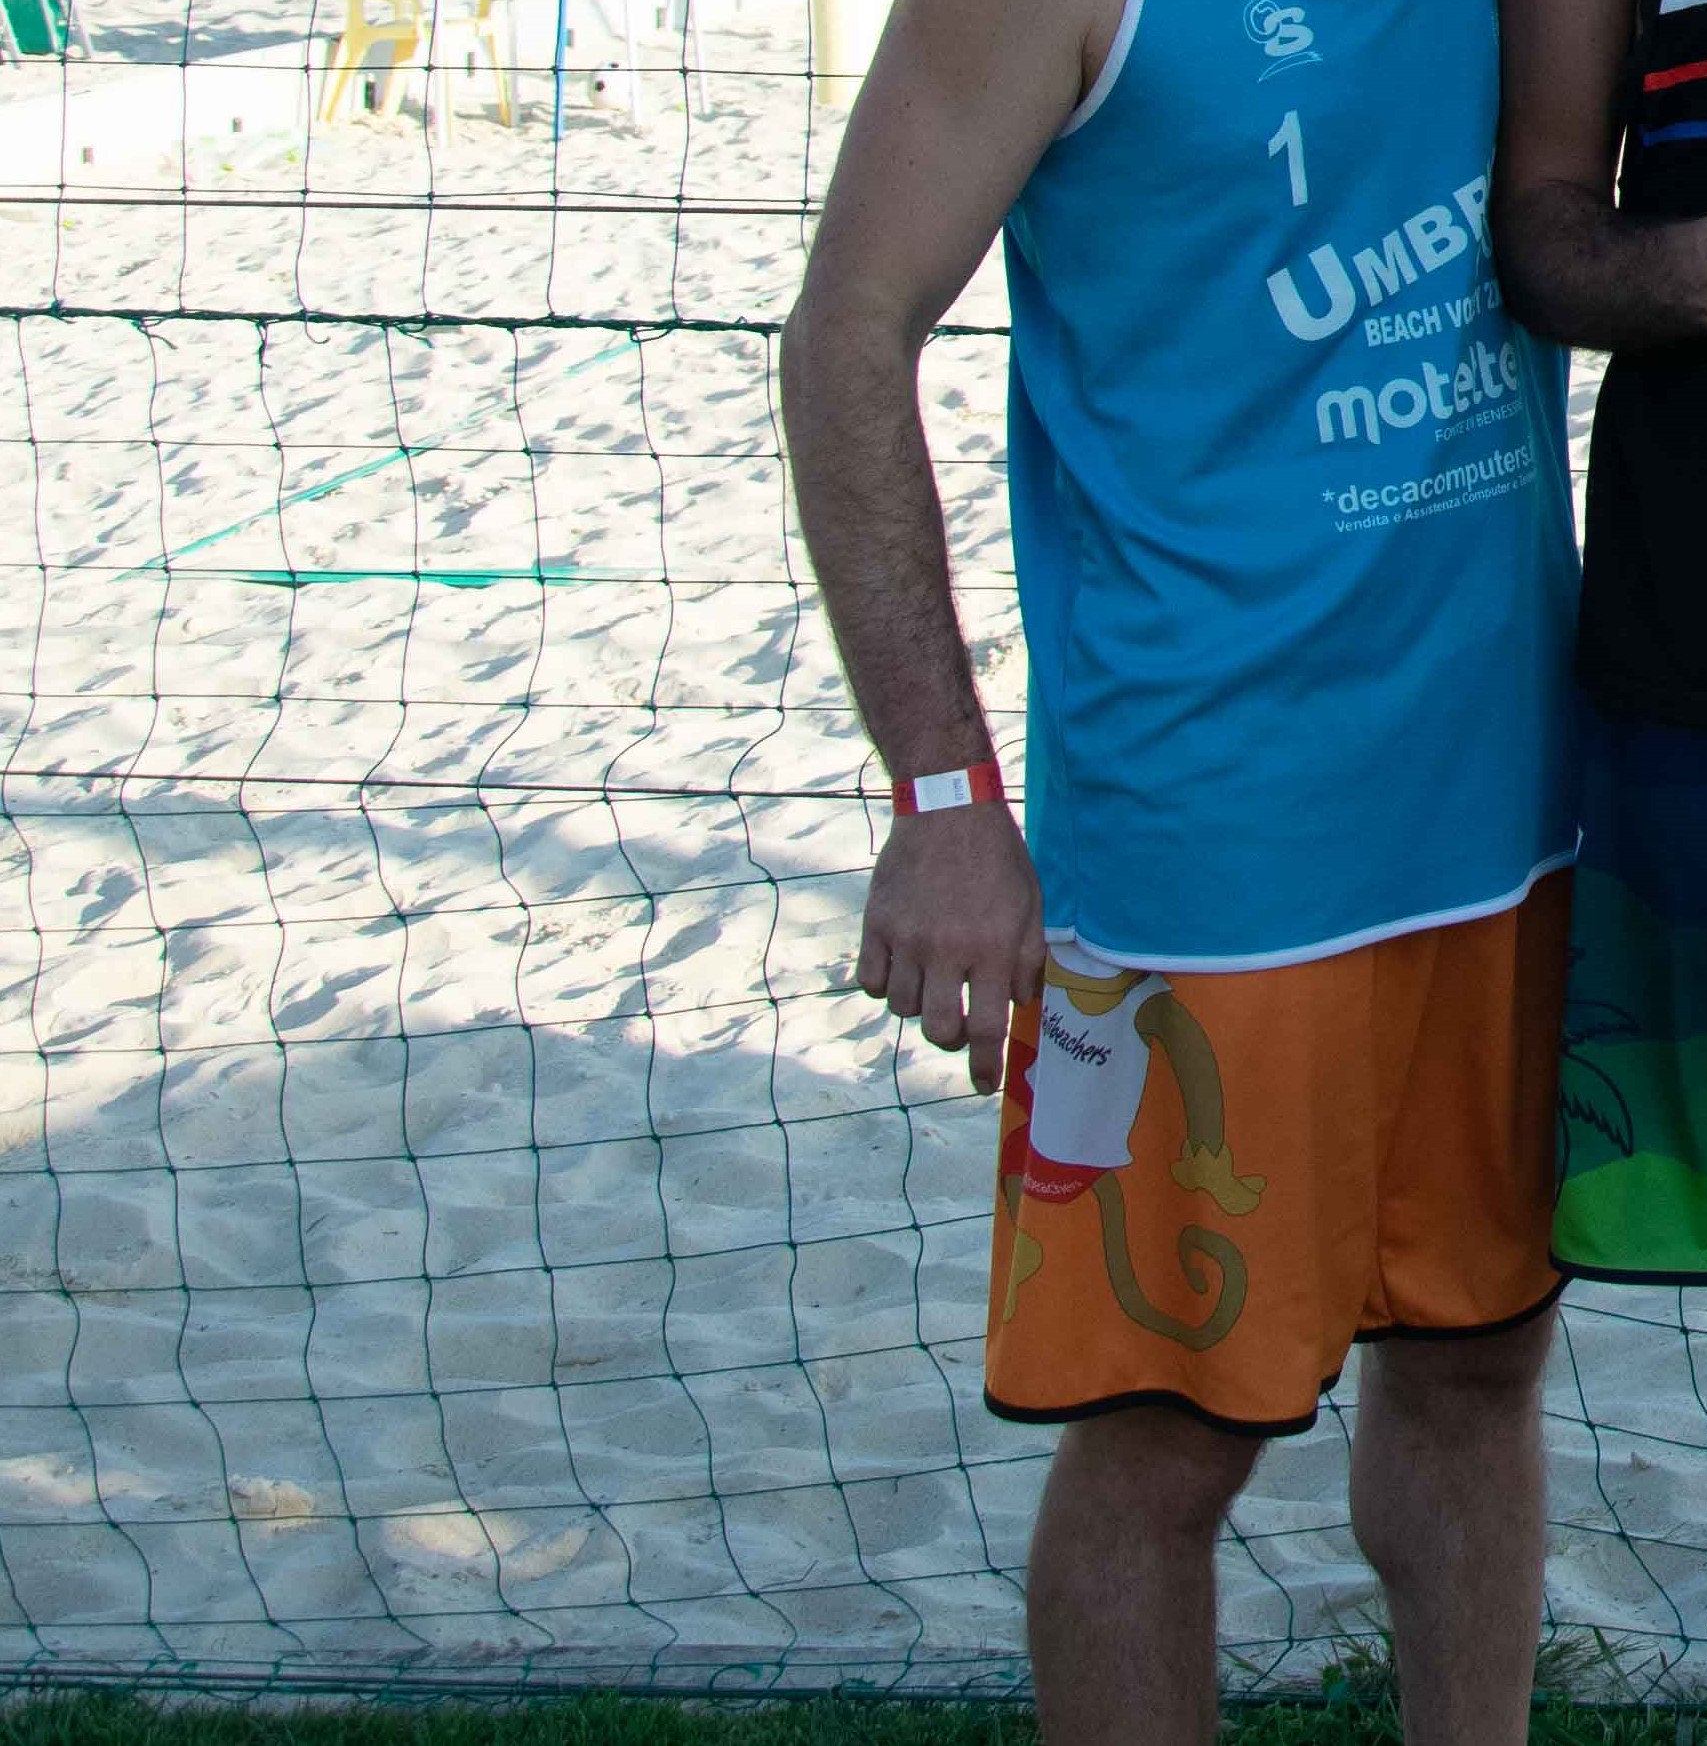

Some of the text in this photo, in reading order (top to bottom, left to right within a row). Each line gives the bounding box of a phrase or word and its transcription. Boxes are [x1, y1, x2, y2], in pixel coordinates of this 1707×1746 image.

[1267, 109, 1308, 207] 1
[1267, 173, 1490, 342] UMBR
[1364, 304, 1442, 348] BEACH
[1335, 513, 1389, 533] Vendita
[1393, 511, 1403, 523] e
[1404, 498, 1461, 522] Assistenza
[1462, 482, 1511, 505] Computer
